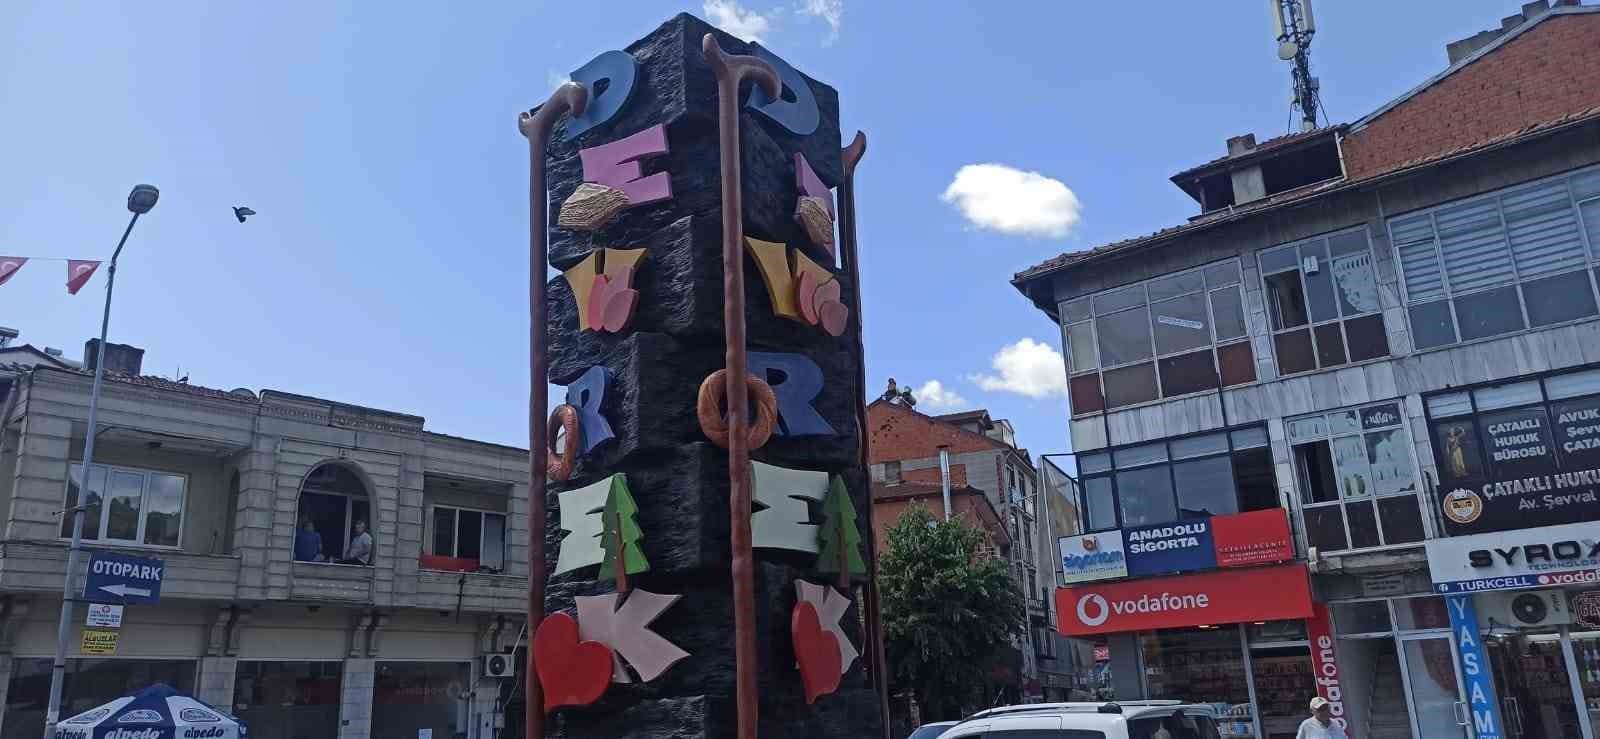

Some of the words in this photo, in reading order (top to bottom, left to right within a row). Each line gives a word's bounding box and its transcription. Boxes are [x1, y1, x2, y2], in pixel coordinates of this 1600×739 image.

[1488, 418, 1540, 436] ÇATAKLI
[1495, 433, 1540, 447] HUKUK
[1493, 445, 1546, 462] BÜROSU
[1482, 476, 1551, 500] ÇATAKLI
[1518, 497, 1540, 511] Av.
[1543, 489, 1597, 509] Şevval
[1129, 522, 1206, 543] ANADOLU
[1130, 537, 1199, 554] SİGORTA
[93, 559, 161, 581] OTOPARK
[1457, 577, 1533, 592] TURKCELL
[1112, 592, 1209, 616] vodafone
[55, 727, 88, 739] alpedo
[105, 727, 161, 739] alpedo
[184, 726, 225, 739] alpedo
